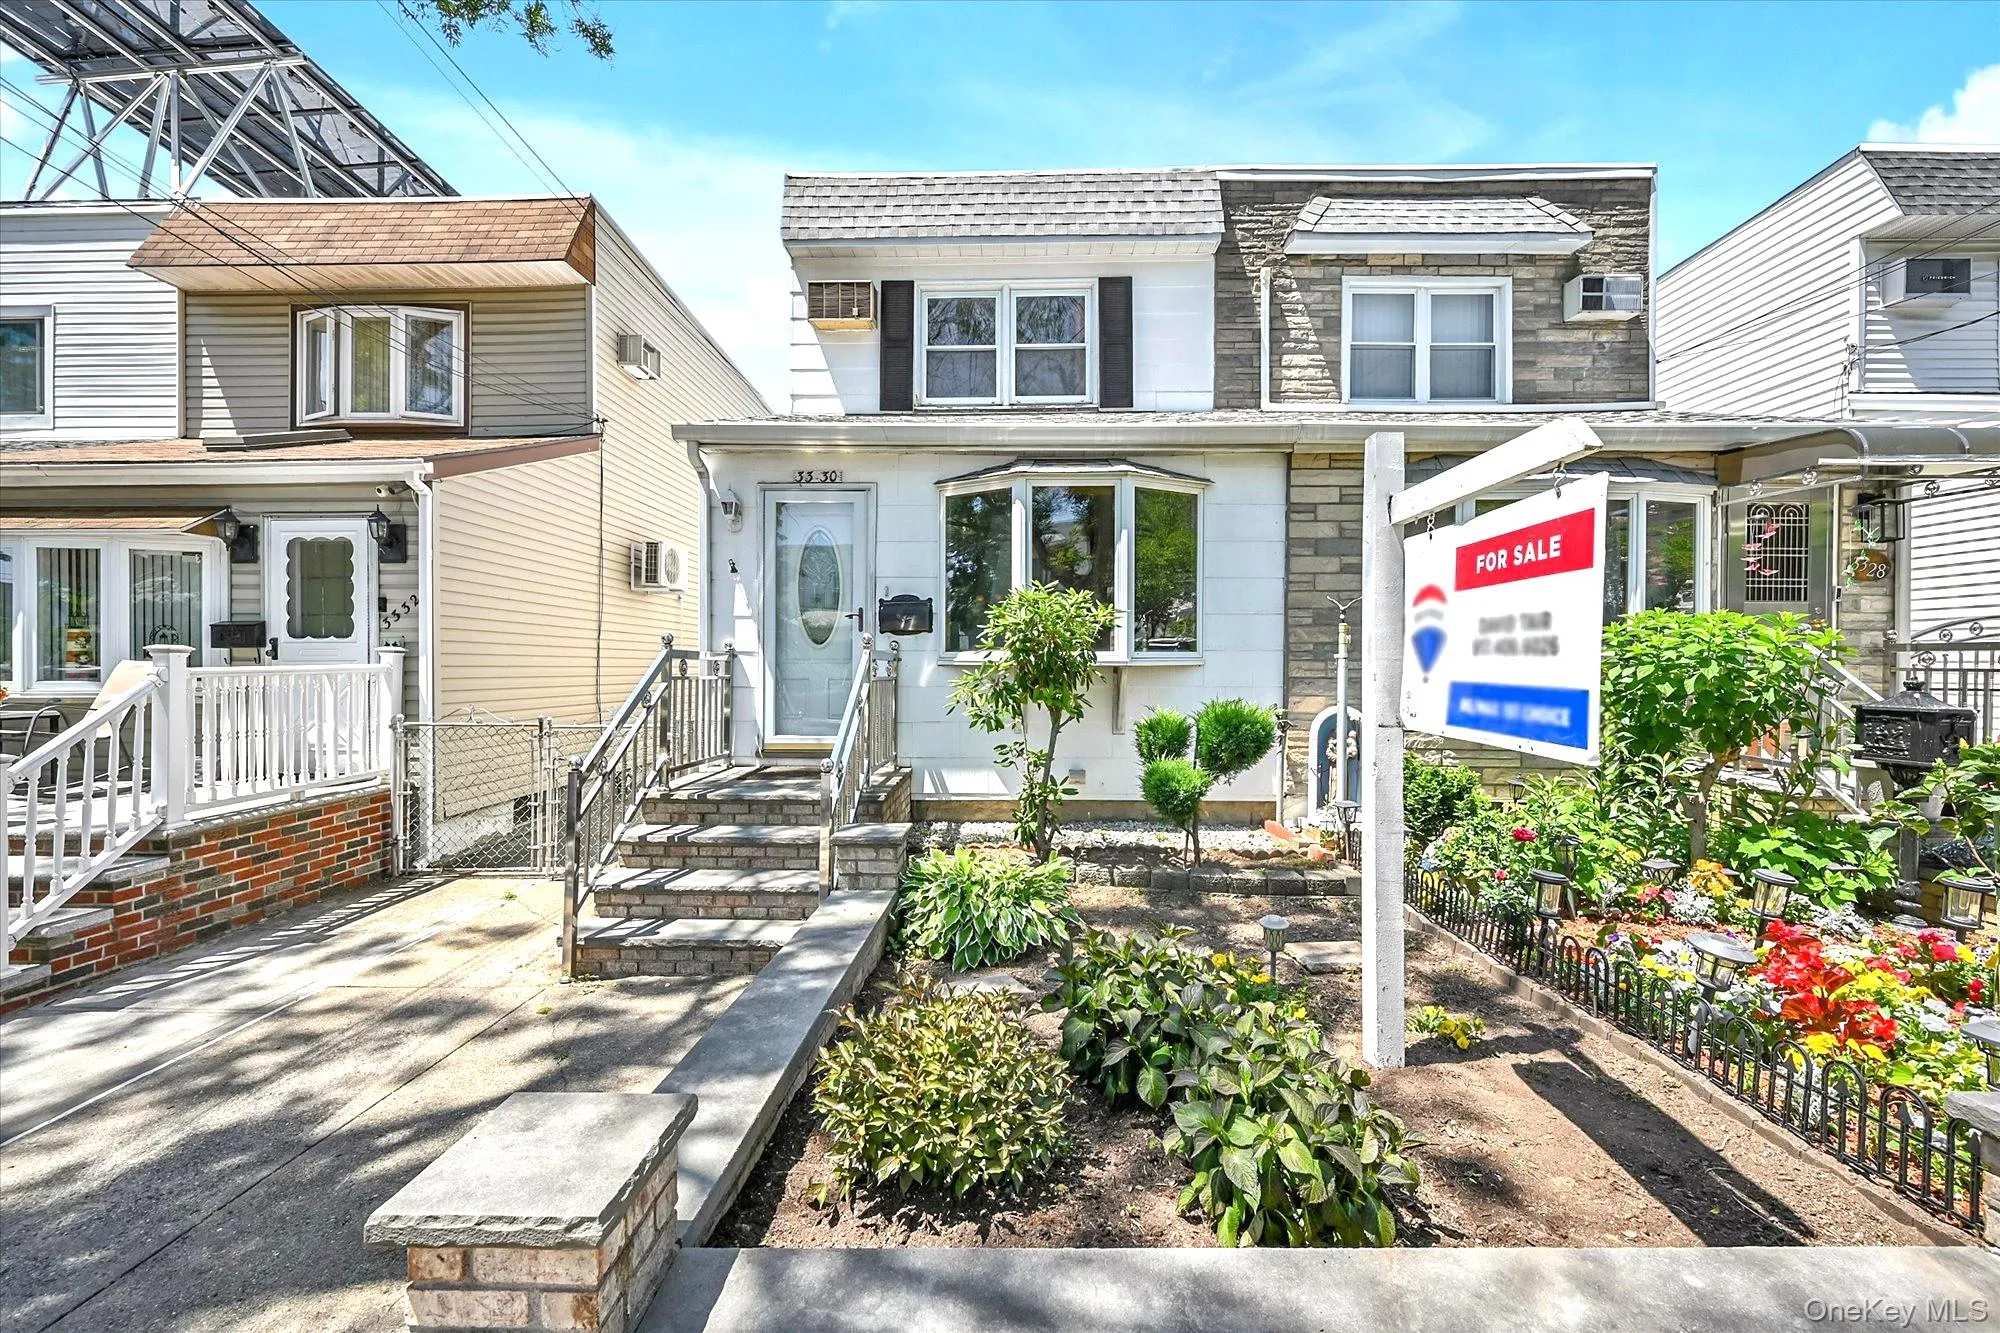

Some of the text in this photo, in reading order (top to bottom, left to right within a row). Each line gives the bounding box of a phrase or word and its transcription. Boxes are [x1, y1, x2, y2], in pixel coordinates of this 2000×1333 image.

[1476, 534, 1562, 574] FOR SALE
[382, 594, 419, 630] 3332
